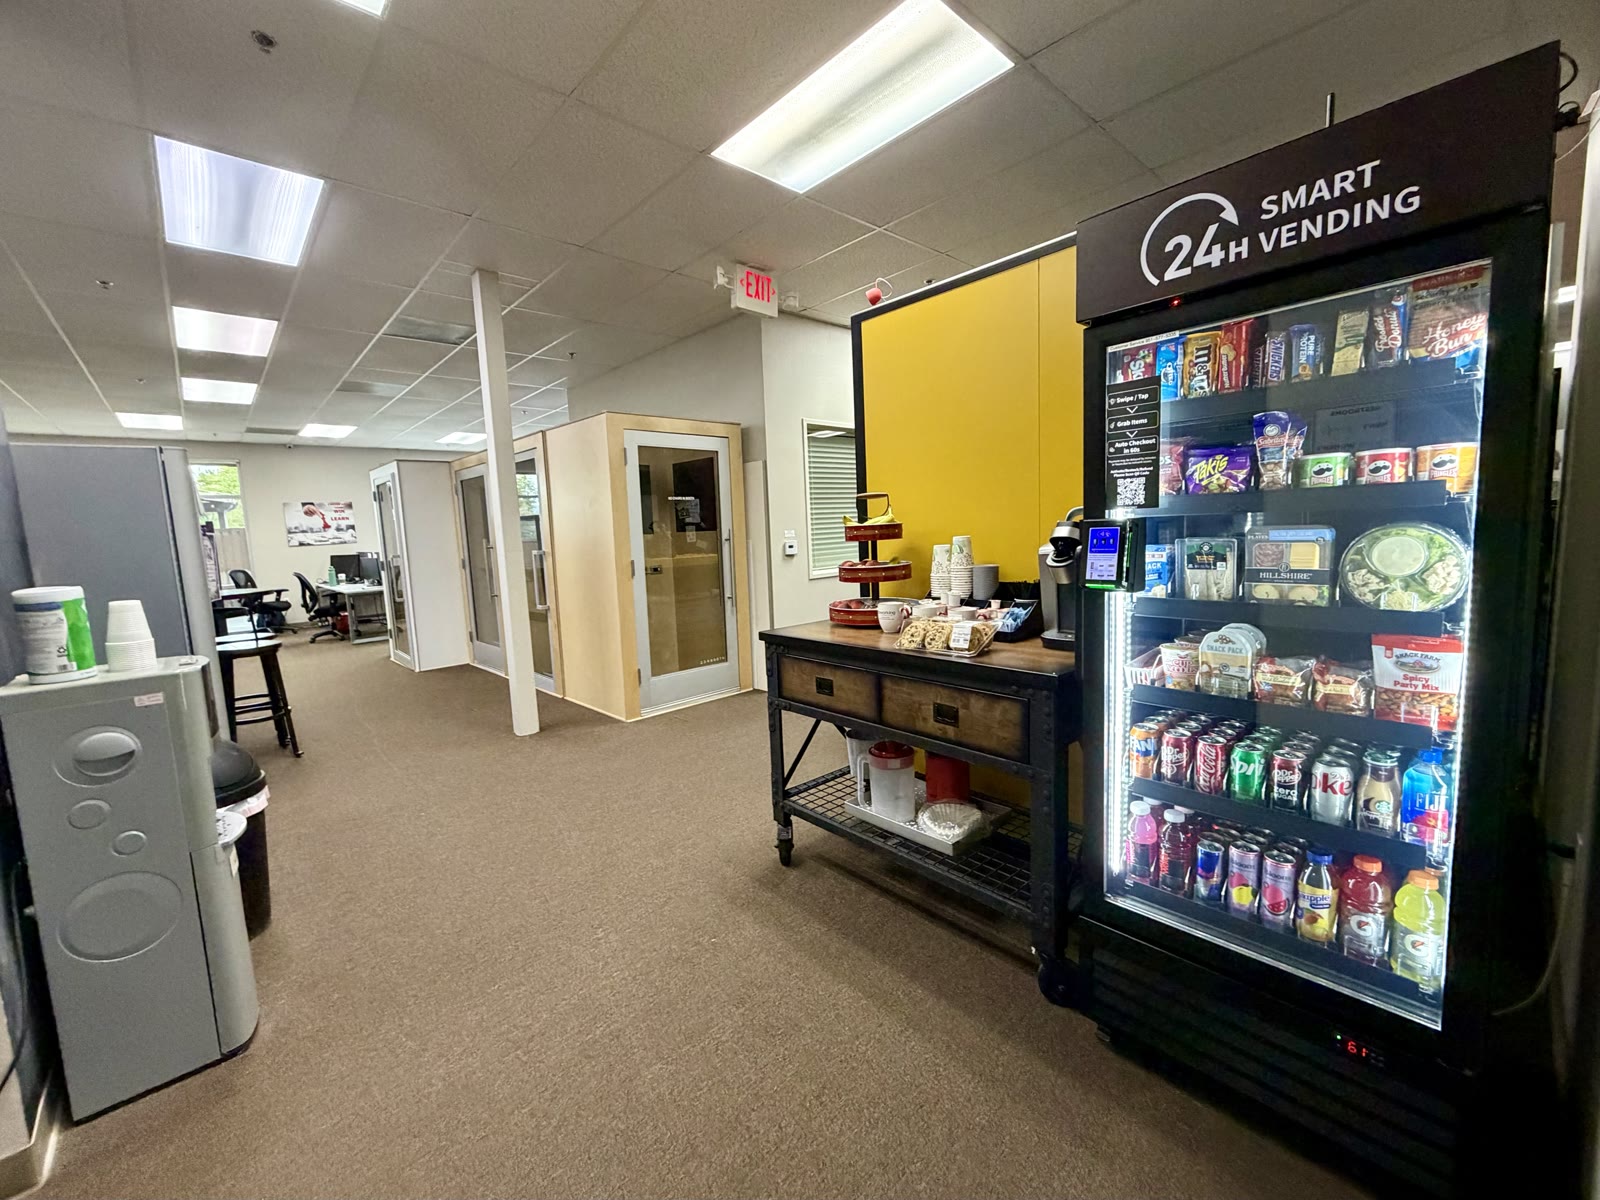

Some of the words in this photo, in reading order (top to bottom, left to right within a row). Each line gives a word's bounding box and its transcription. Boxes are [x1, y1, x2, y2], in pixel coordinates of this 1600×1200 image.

[1260, 159, 1380, 220] SMART
[1164, 222, 1249, 281] 24H
[1258, 186, 1421, 254] VENDING
[745, 270, 772, 303] EXIT
[1423, 314, 1486, 343] Honey
[1306, 334, 1315, 355] PURE
[1427, 332, 1473, 357] Bun
[1269, 338, 1284, 381] SNICKERS
[1116, 396, 1134, 404] Swipe
[1138, 393, 1149, 401] Tap
[1131, 418, 1148, 426] Items
[1129, 439, 1156, 447] Checkout
[1195, 454, 1229, 482] Takis
[1430, 470, 1458, 478] PRINGLES
[1259, 572, 1312, 580] HILLSHIRE
[1206, 644, 1227, 653] SNACK
[1227, 646, 1244, 655] PACK
[1420, 652, 1442, 663] FARM
[1172, 659, 1193, 668] CUP
[1394, 680, 1419, 691] Party
[1421, 683, 1440, 691] Mix
[1402, 673, 1430, 684] Spicy
[1231, 754, 1265, 776] Spri
[1274, 787, 1298, 796] zero
[1312, 772, 1352, 796] oke
[1415, 791, 1450, 812] FIJI
[1351, 914, 1377, 937] G
